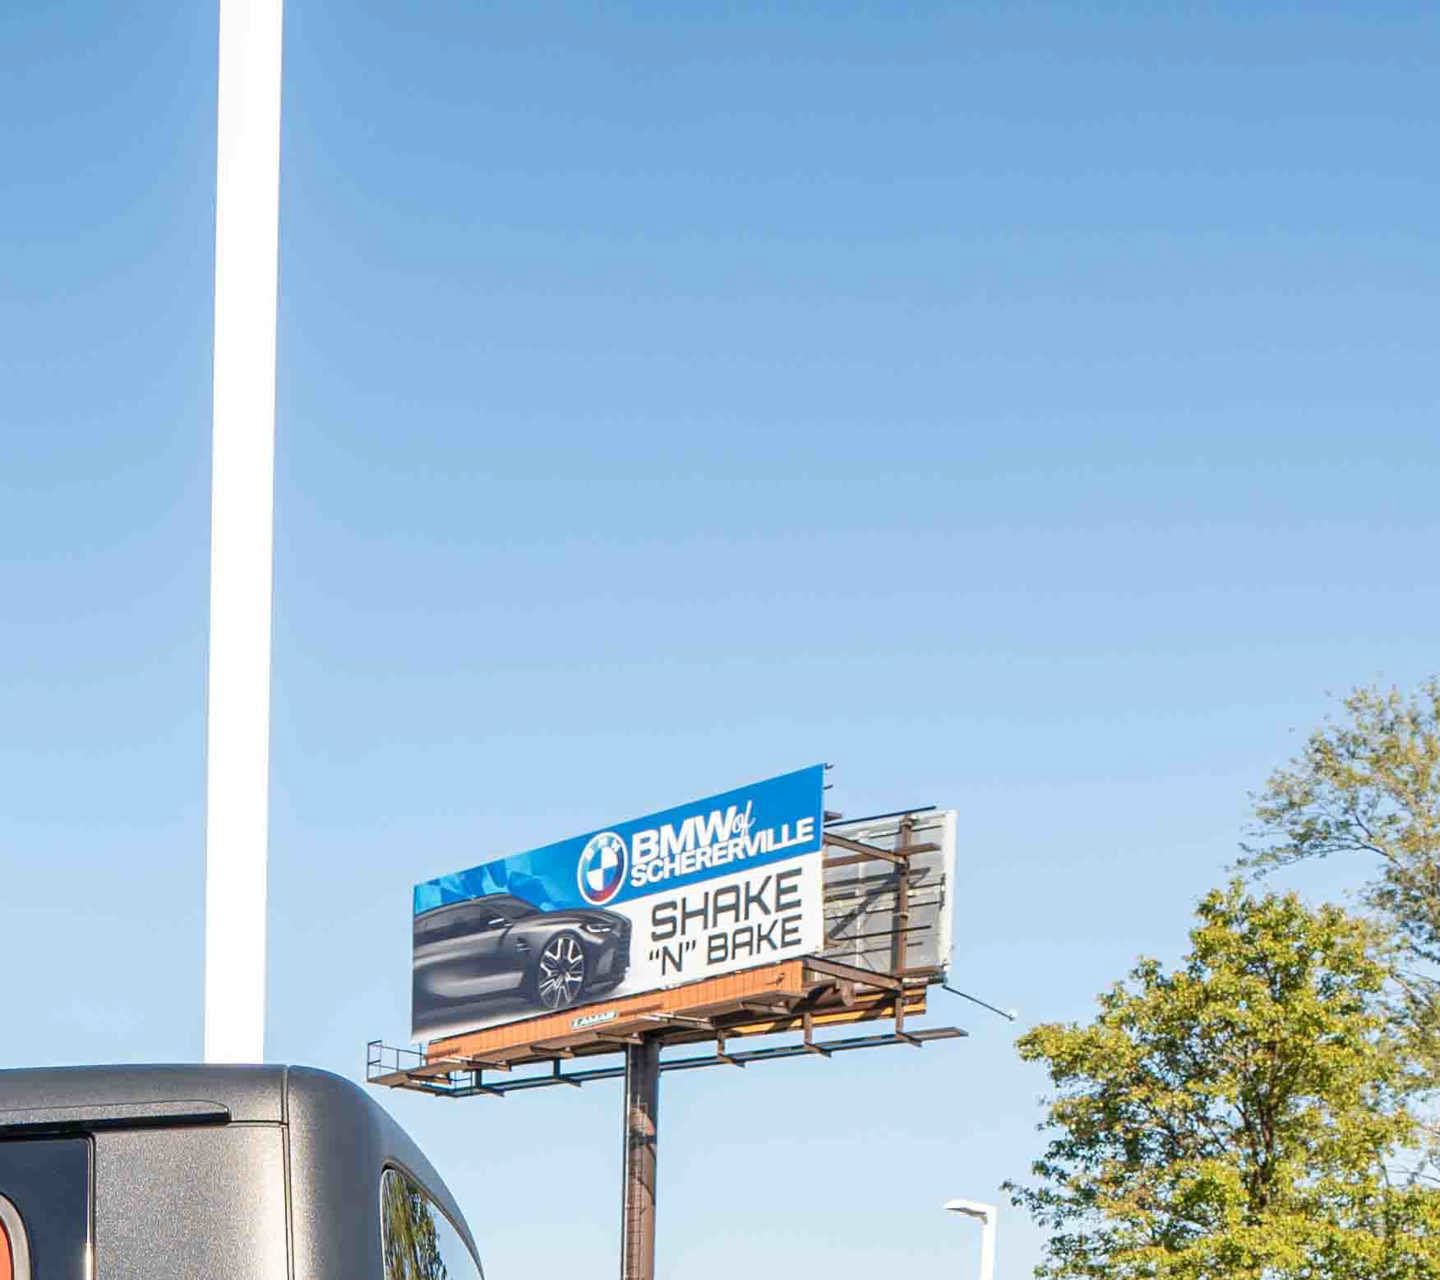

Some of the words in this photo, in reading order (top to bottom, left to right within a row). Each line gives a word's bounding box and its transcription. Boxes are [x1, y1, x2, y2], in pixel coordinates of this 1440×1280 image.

[630, 816, 815, 887] SCHERERVILLE
[631, 805, 738, 865] BMW
[732, 800, 756, 840] of
[650, 867, 803, 942] SHAKE
[707, 913, 803, 966] BAKE
